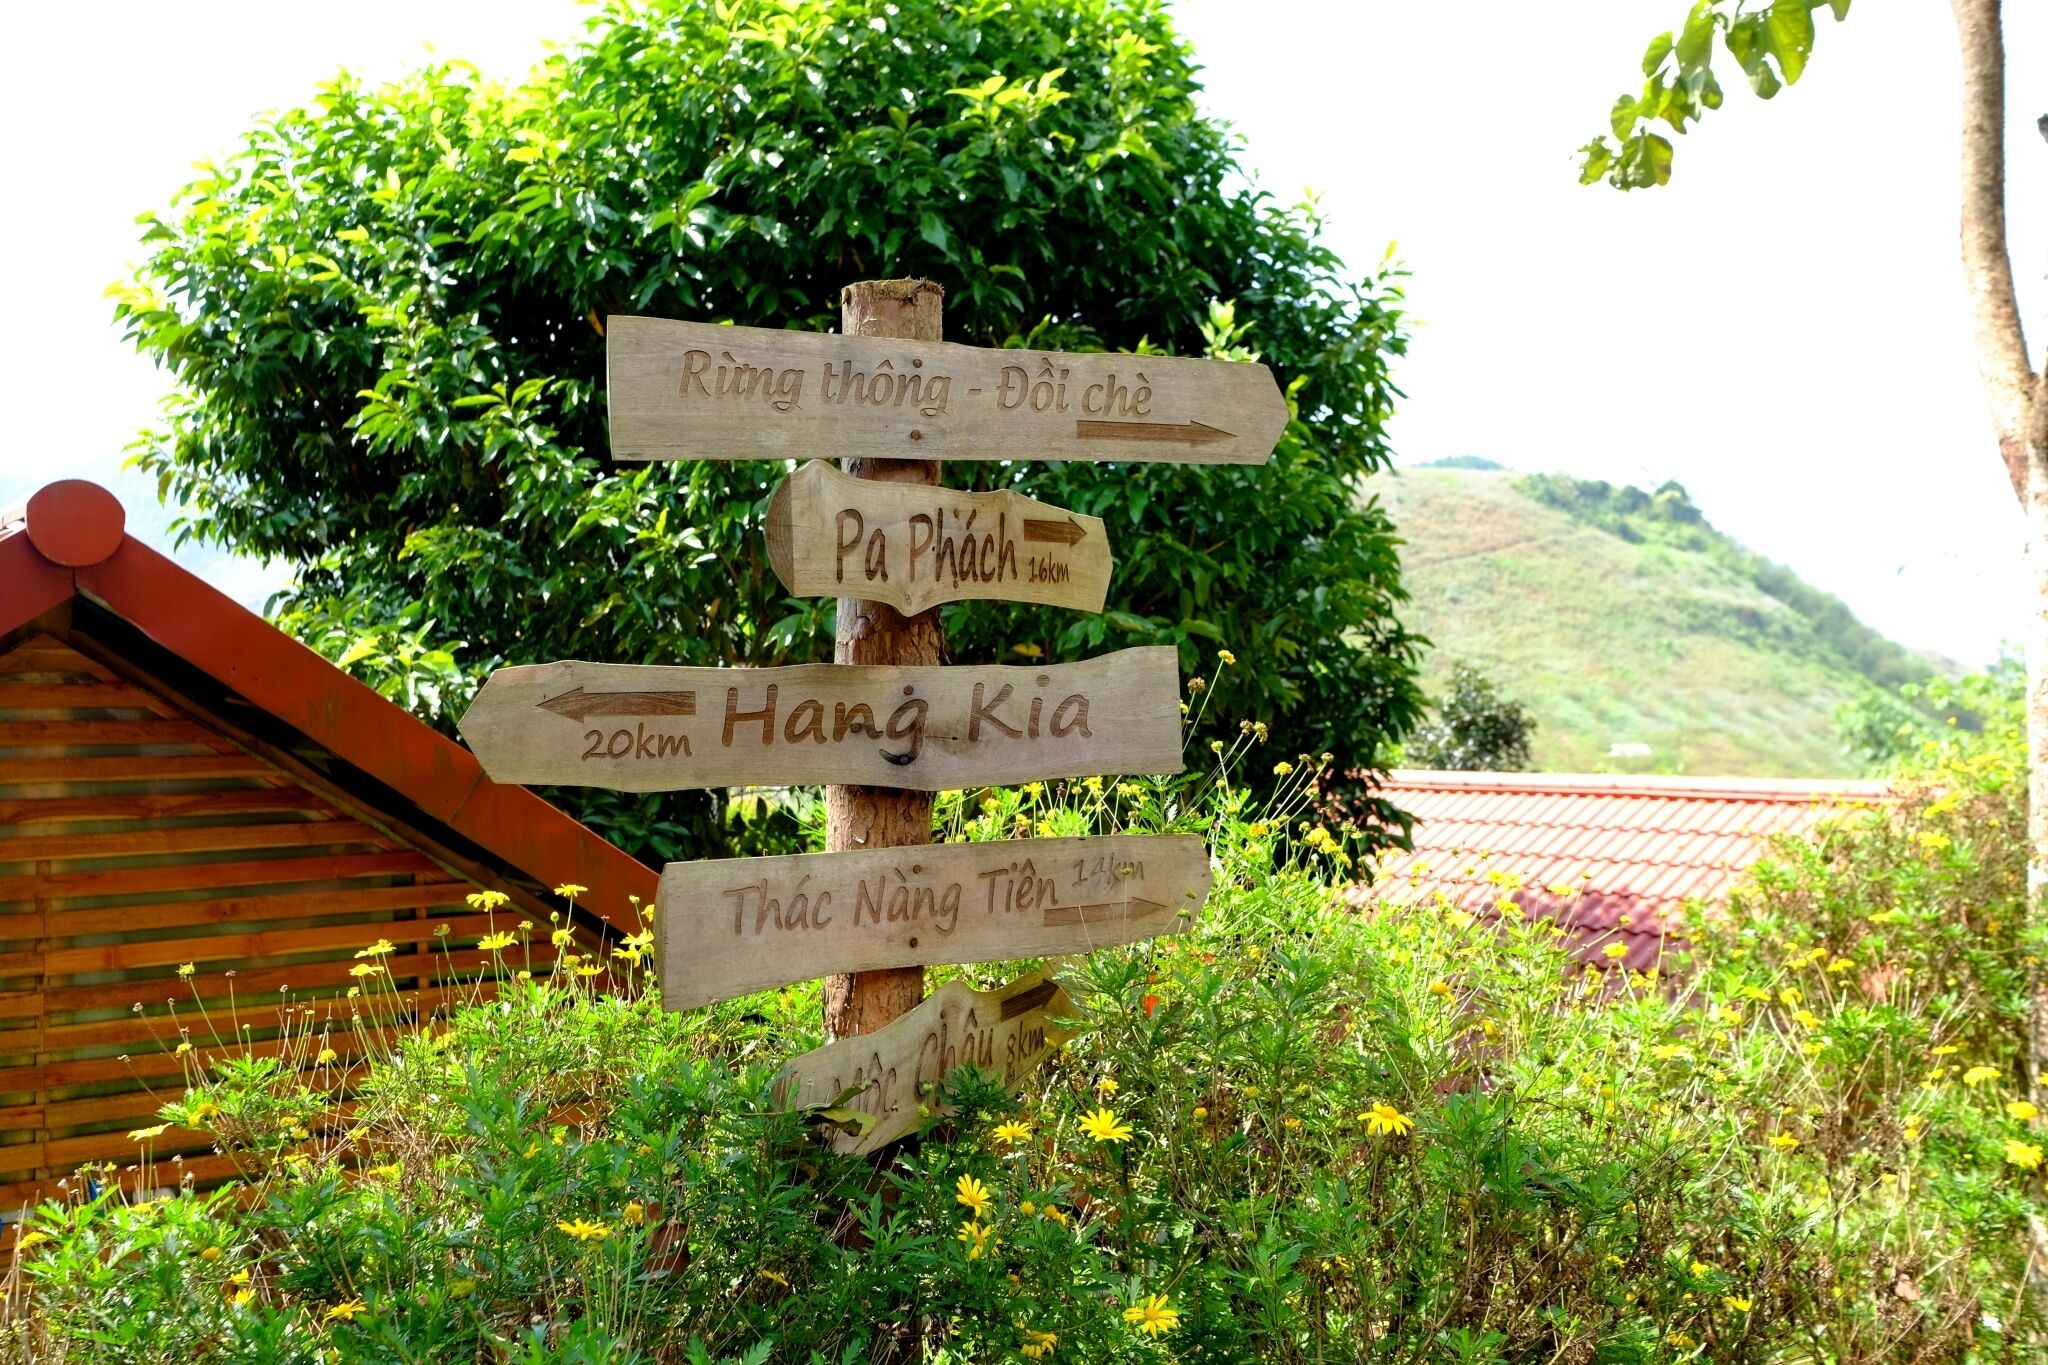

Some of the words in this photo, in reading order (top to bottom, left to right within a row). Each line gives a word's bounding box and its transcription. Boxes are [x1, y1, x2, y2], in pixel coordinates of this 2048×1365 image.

[679, 350, 805, 411] Rừng
[820, 359, 951, 416] thông
[967, 388, 982, 396] -
[996, 357, 1069, 412] Đồi
[1081, 372, 1152, 417] chè
[835, 508, 888, 584] Pa
[908, 507, 1017, 583] Phách
[1028, 551, 1069, 584] 16km
[582, 722, 692, 761] 20km
[721, 684, 926, 765] Hang
[967, 675, 1092, 742] Kia
[723, 874, 832, 935] Thác
[853, 868, 961, 935] Nàng
[978, 858, 1059, 913] Tiên
